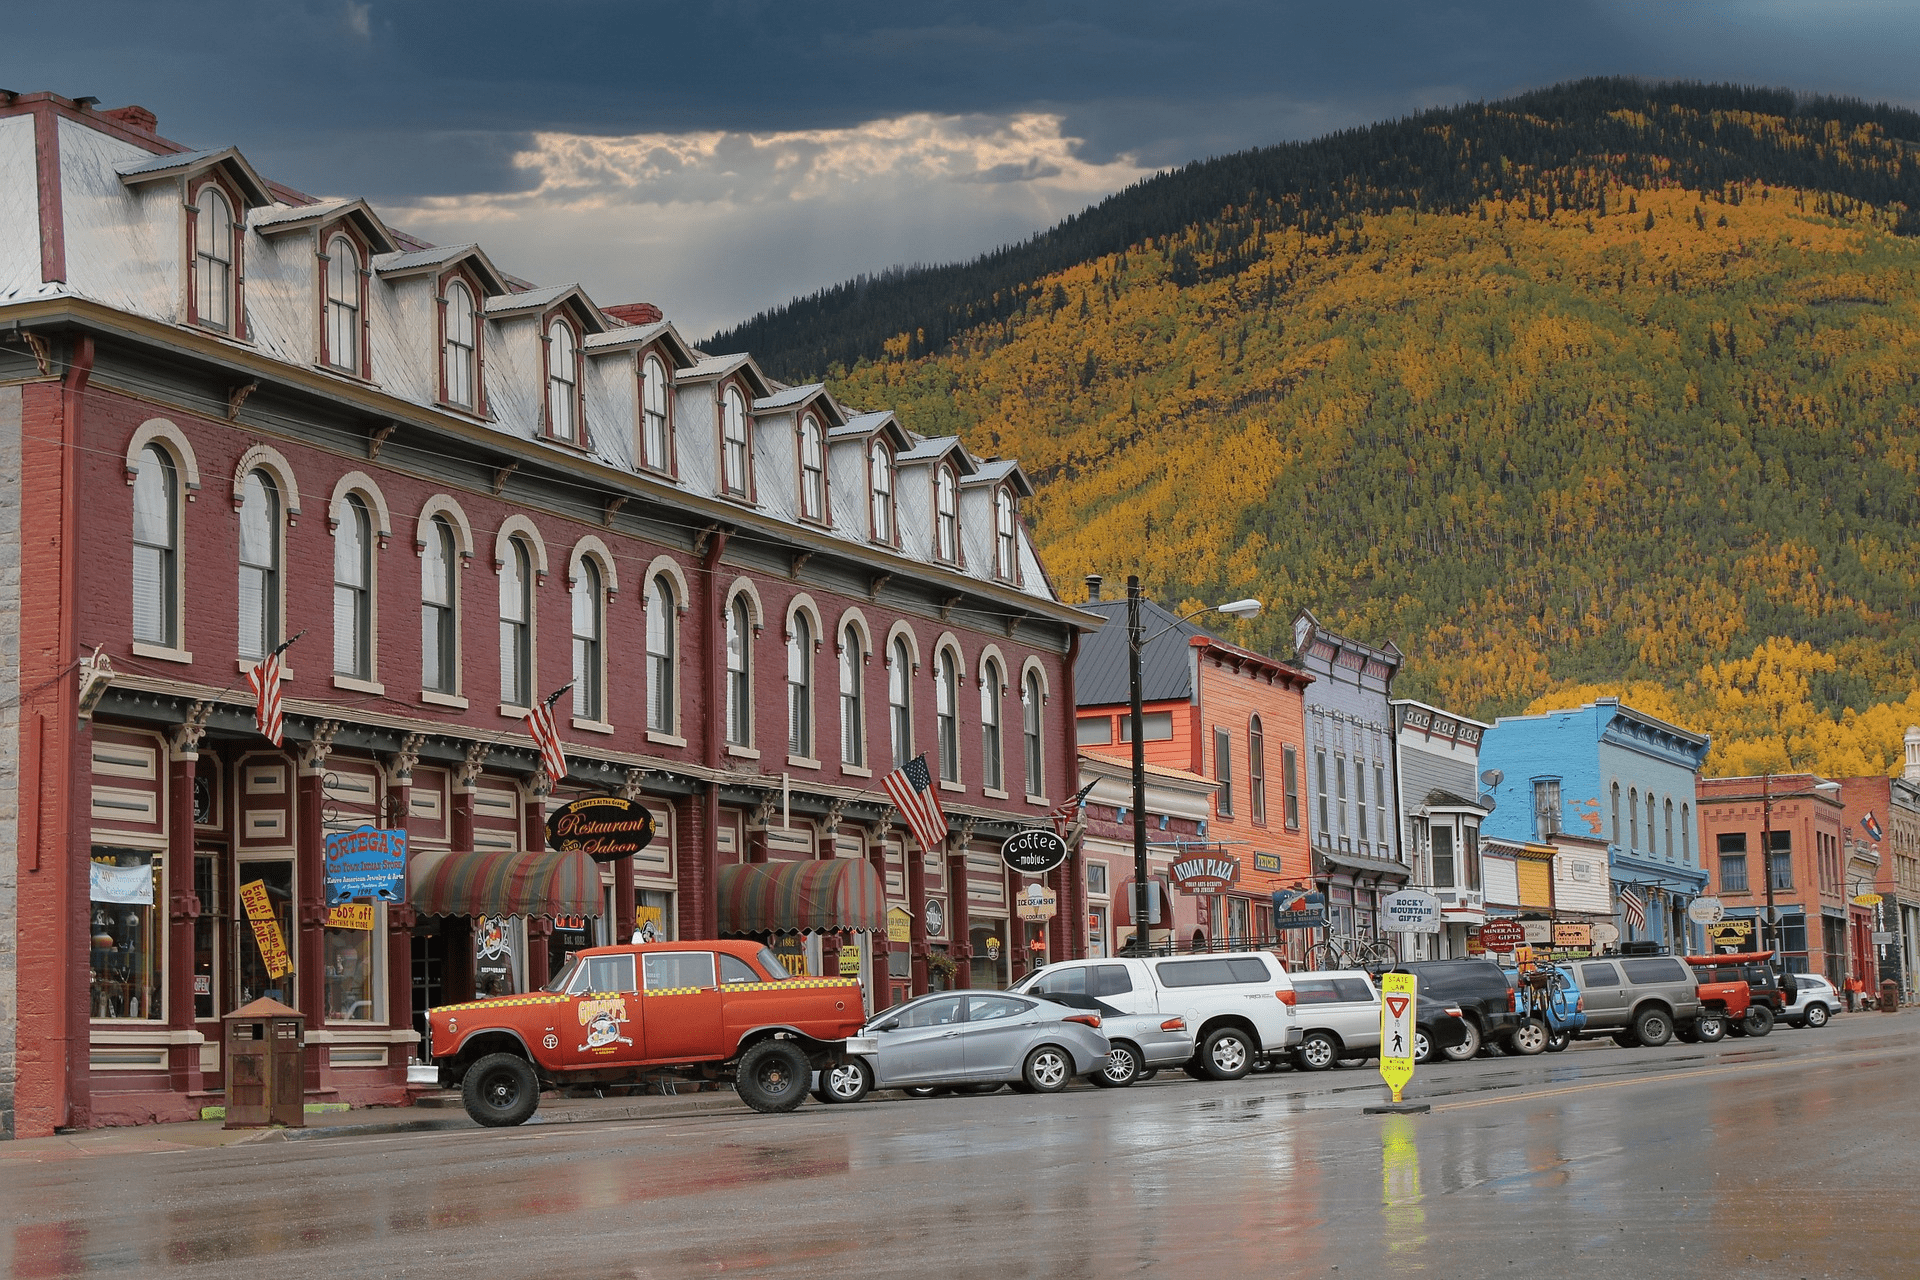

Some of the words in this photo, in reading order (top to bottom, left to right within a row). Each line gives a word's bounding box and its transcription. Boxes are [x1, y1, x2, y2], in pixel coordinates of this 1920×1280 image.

[557, 813, 644, 836] Restaurant
[328, 832, 405, 861] ORTEGA'S
[564, 841, 579, 852] AND
[583, 837, 638, 855] Saloon
[1009, 833, 1057, 853] coffee
[1173, 858, 1205, 882] INDIAN
[1206, 858, 1234, 881] PLAZA
[253, 884, 267, 902] End
[259, 904, 272, 914] of
[358, 907, 372, 921] off
[1390, 906, 1432, 914] MOUNTAIN
[1708, 921, 1749, 930] HANDLEBARS
[782, 937, 795, 948] 1882
